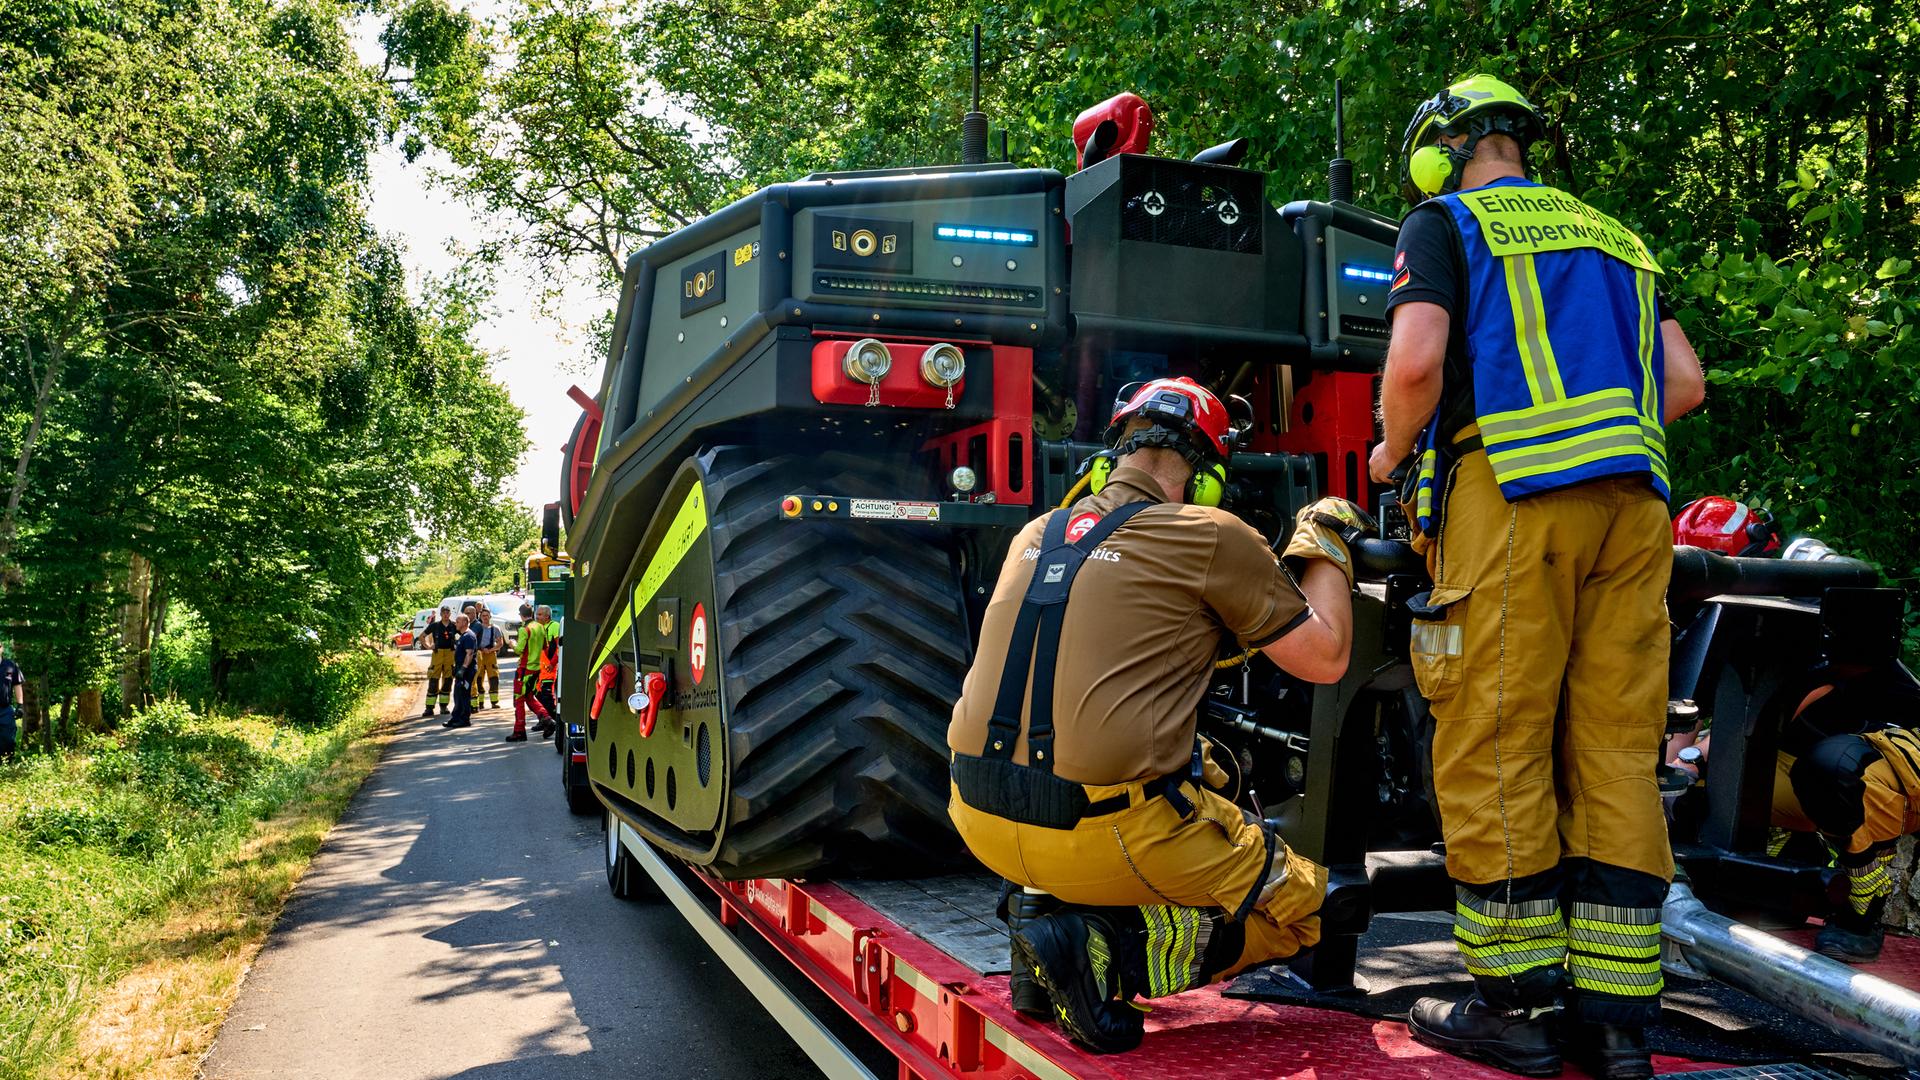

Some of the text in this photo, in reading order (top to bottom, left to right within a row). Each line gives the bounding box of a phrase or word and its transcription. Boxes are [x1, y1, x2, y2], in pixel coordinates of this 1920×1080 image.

[1489, 221, 1652, 264] Superwolf HR1
[855, 503, 892, 511] ACHTUNG!
